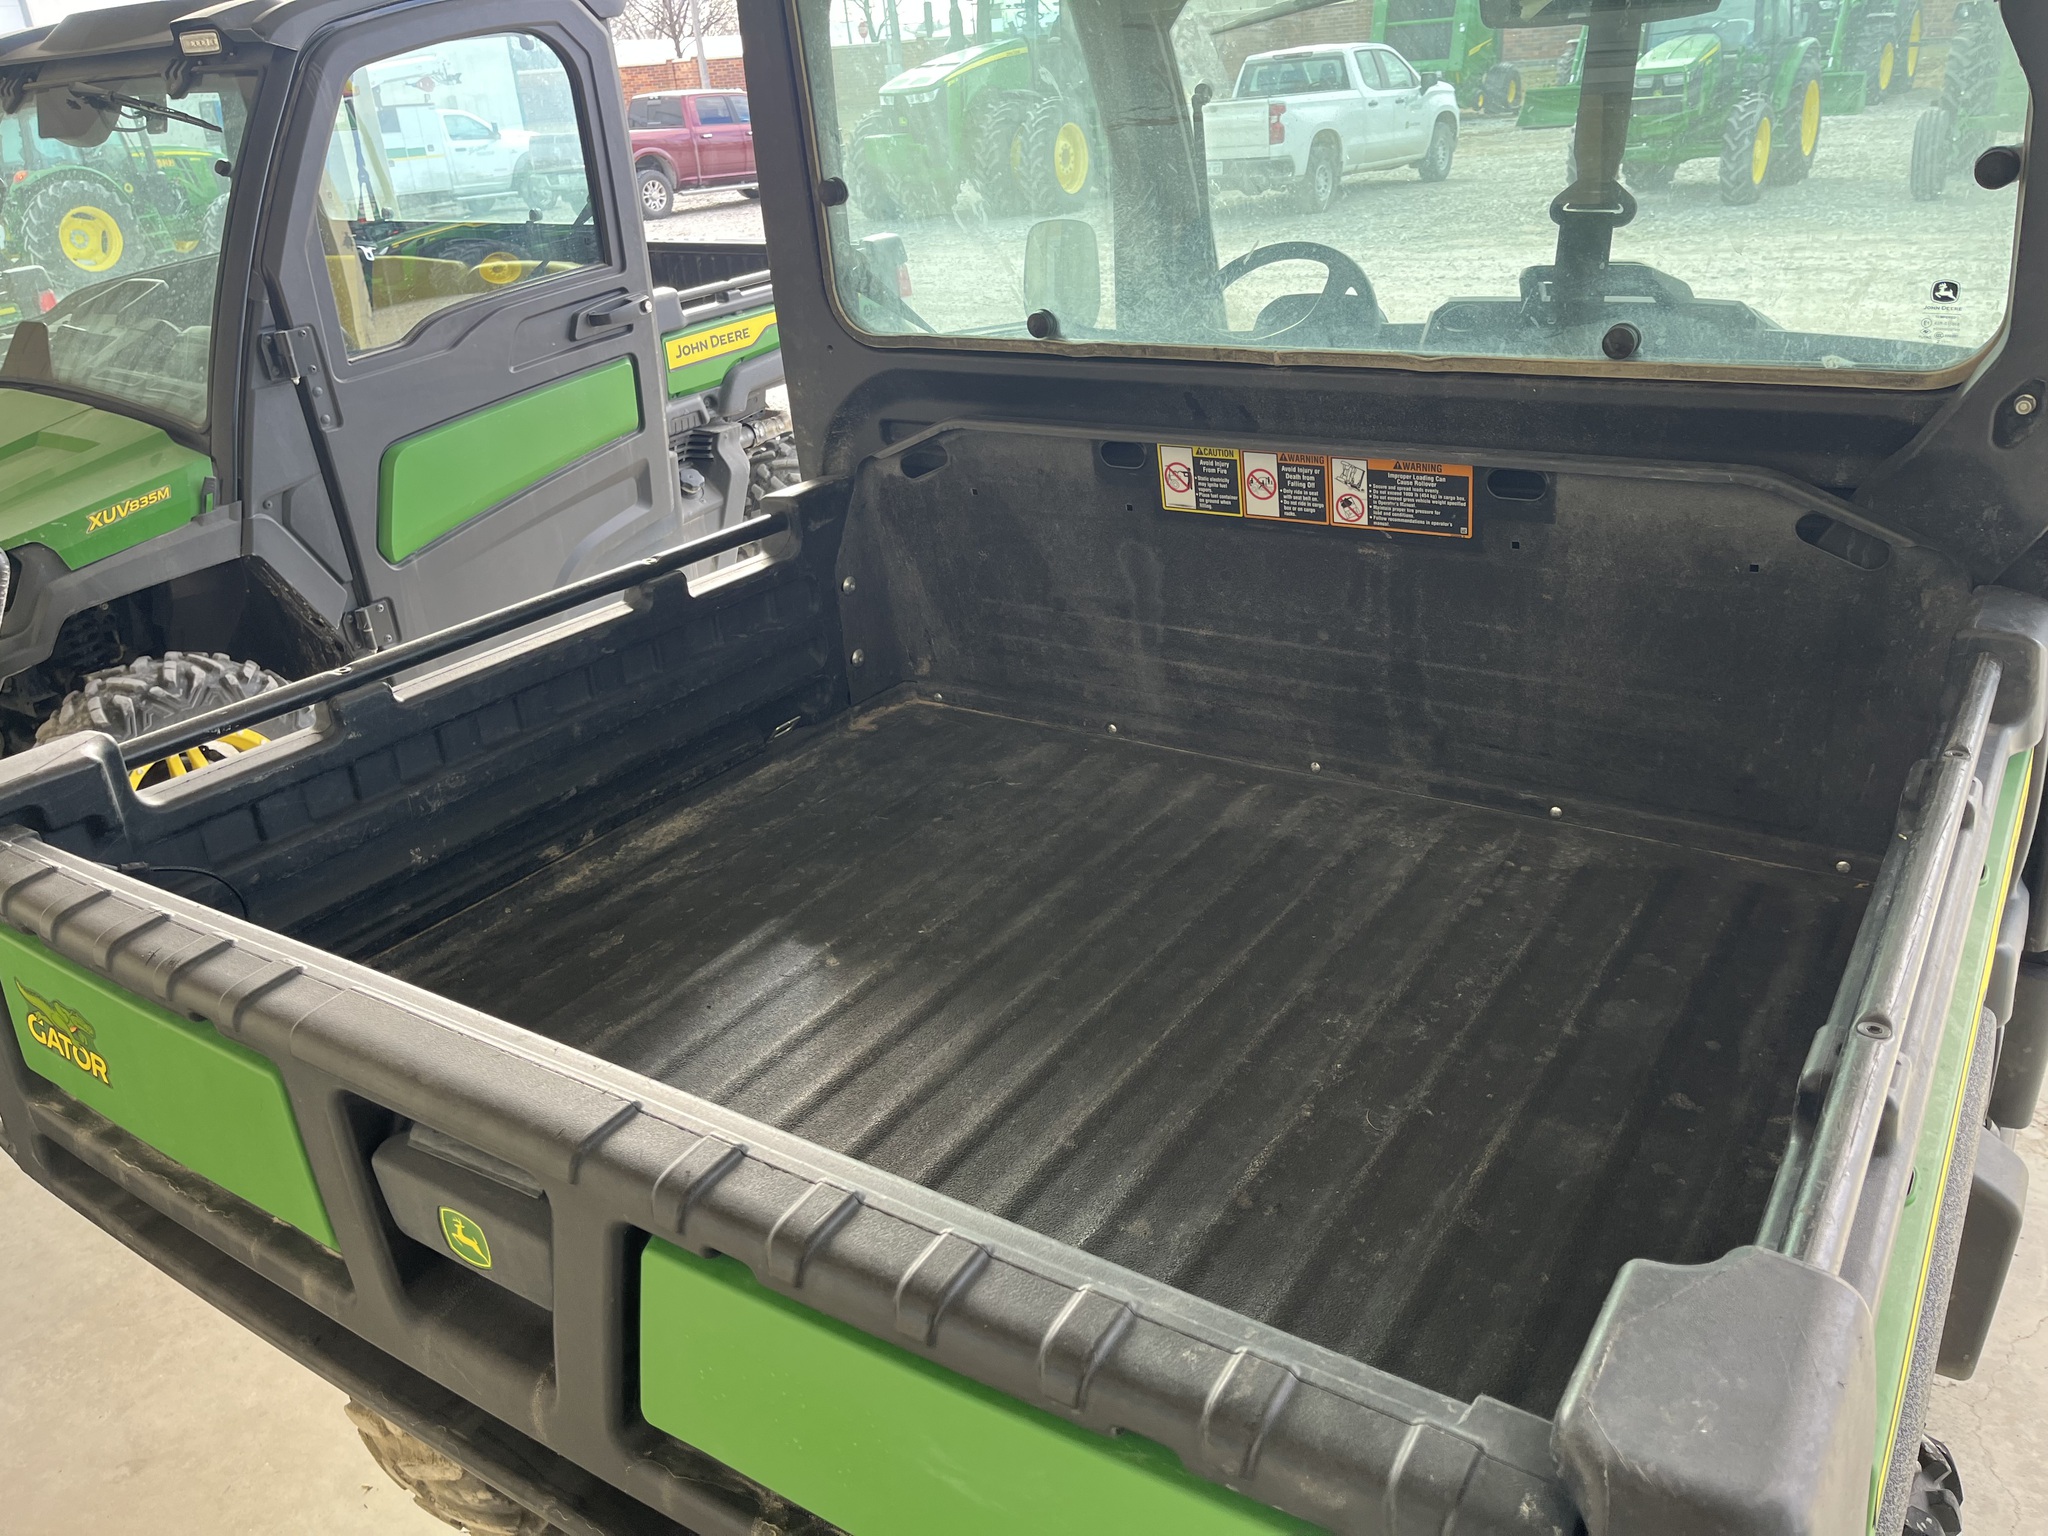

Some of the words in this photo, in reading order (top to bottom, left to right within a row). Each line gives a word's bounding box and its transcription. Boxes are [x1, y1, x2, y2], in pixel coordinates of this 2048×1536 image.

[676, 340, 708, 359] JOHN
[710, 328, 750, 348] DEERE
[1203, 448, 1234, 457] CAUTION
[1288, 454, 1324, 464] WARNING
[1297, 467, 1313, 475] Injury
[1402, 462, 1443, 473] WARNING
[1288, 480, 1305, 488] Falling
[88, 486, 170, 532] XUV835M
[27, 1013, 109, 1084] GATOR
